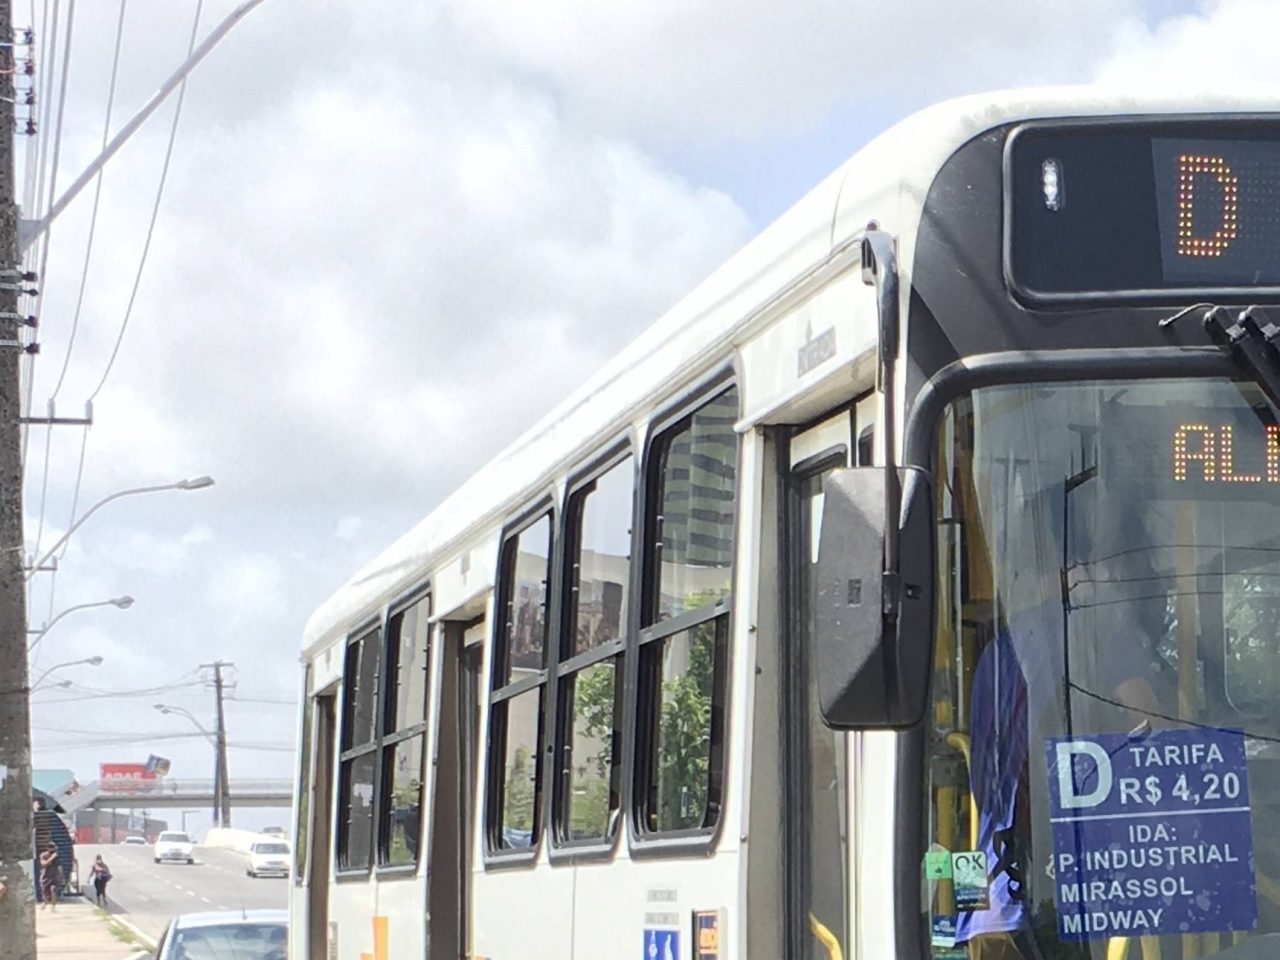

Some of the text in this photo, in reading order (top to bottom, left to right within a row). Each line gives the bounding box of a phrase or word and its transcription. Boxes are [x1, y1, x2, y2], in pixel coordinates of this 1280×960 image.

[1178, 155, 1238, 257] D
[1129, 743, 1225, 768] TARIFA
[1055, 741, 1113, 809] D
[1119, 772, 1241, 806] R$ 4,20
[1129, 824, 1177, 843] IDA:
[1059, 845, 1239, 872] P. INDUSTRIAL
[1061, 877, 1193, 903] MIRASSOL
[1064, 908, 1164, 934] MIDWAY
